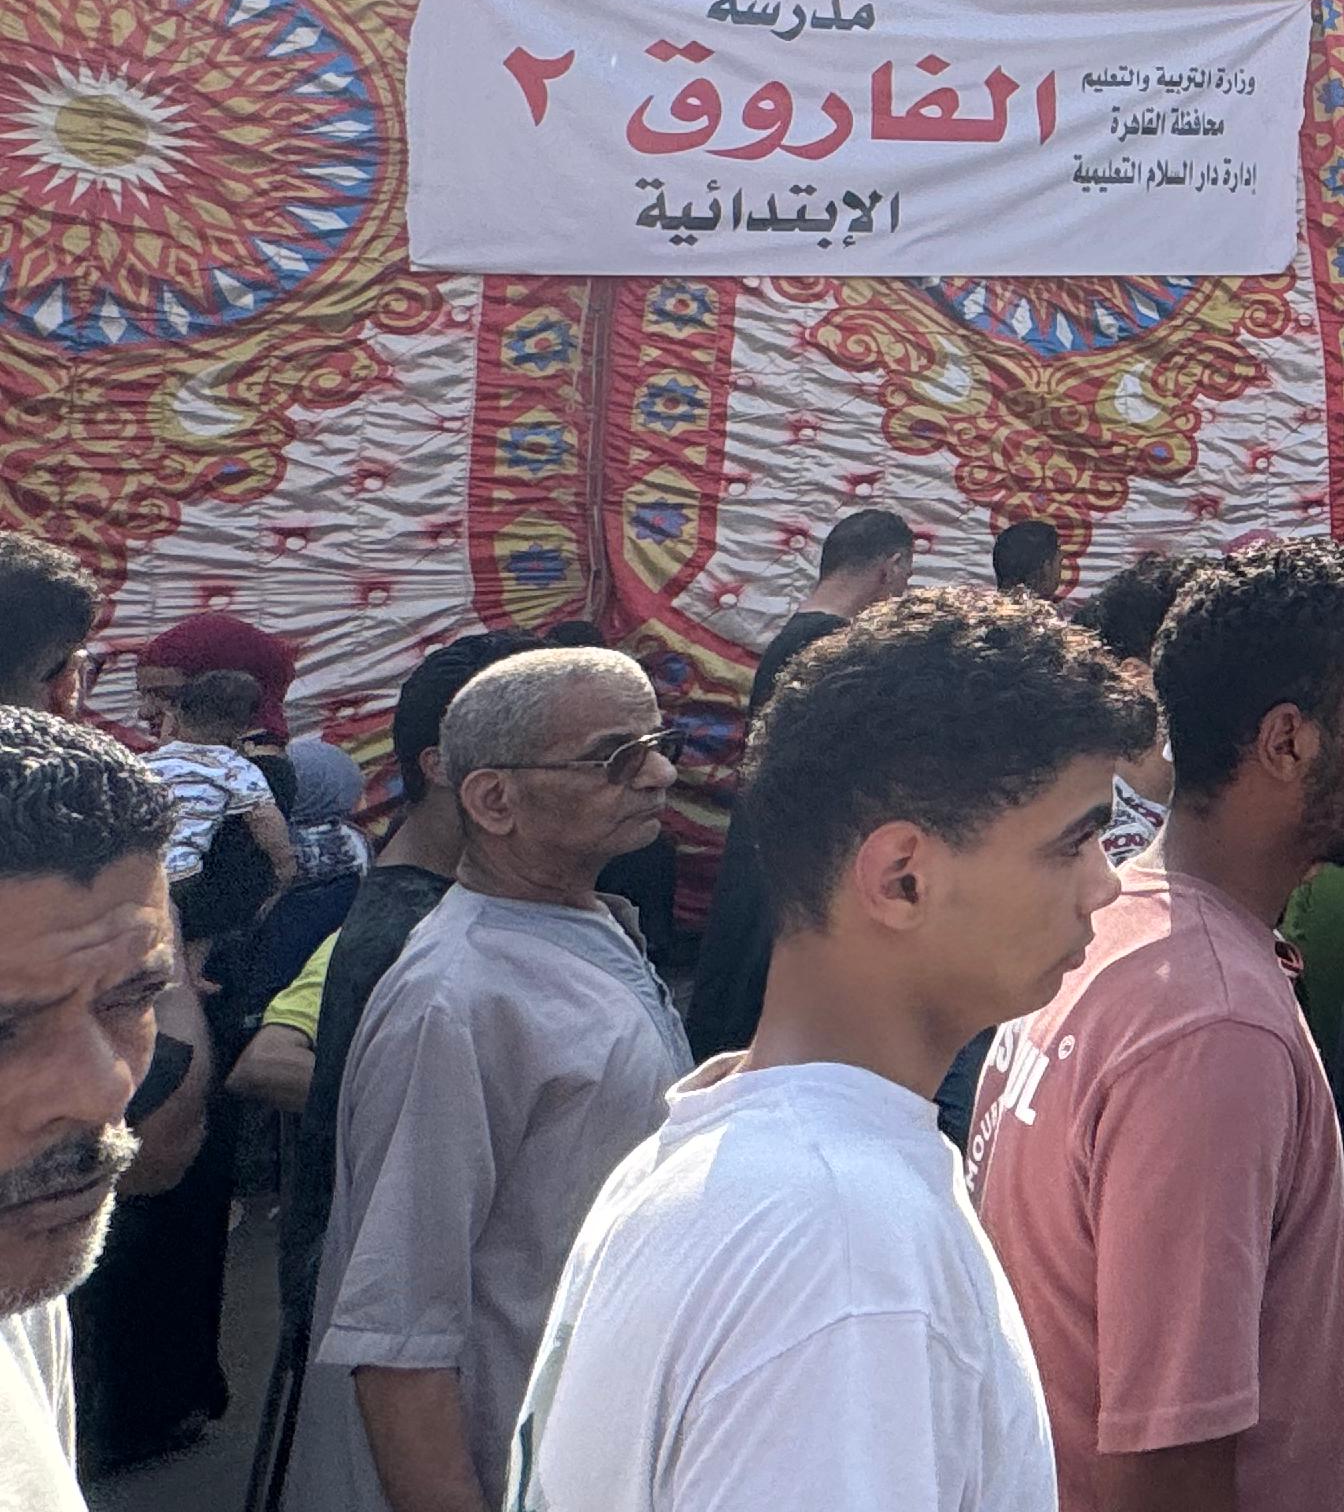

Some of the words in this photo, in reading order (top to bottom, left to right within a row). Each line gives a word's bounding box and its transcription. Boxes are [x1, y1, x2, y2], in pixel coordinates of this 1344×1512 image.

[503, 46, 575, 127] ٢
[1082, 65, 1150, 93] والتعليم
[1156, 65, 1212, 94] التربية
[1215, 68, 1256, 95] وزارة
[626, 39, 1056, 160] الفاروق
[1110, 106, 1165, 142] القاهرة
[1170, 107, 1224, 136] محافظة
[1073, 154, 1142, 193] التعليمية
[1146, 160, 1193, 192] السلام
[1195, 161, 1219, 192] دار
[1222, 158, 1257, 195] إدارة
